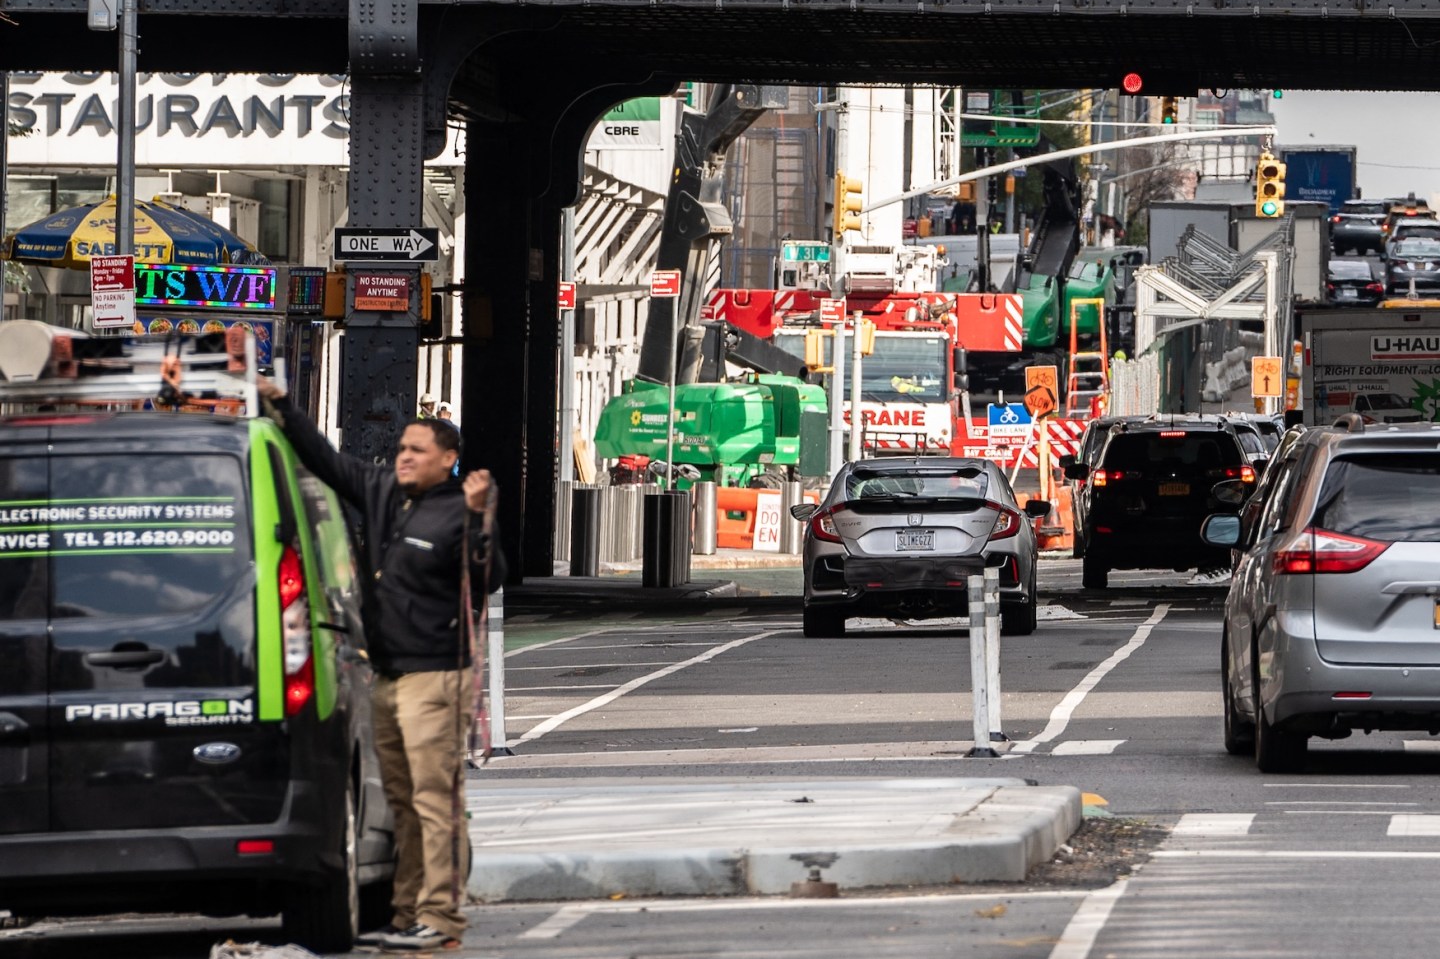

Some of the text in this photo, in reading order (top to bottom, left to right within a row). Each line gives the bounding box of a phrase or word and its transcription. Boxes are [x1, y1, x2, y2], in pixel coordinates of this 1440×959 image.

[604, 126, 640, 136] CBRE
[76, 241, 167, 258] SABETT
[349, 237, 423, 251] ONE WAY
[804, 247, 815, 260] 31
[102, 259, 127, 267] STANDING
[196, 272, 270, 303] W/F
[360, 277, 406, 287] NO STANDING
[366, 288, 398, 297] ANYTIME
[96, 303, 116, 312] Anytime
[1325, 366, 1356, 376] RIGHT
[1358, 365, 1418, 376] EQUIPMENT
[1029, 394, 1050, 410] SLOW
[963, 449, 980, 457] BAY
[88, 505, 163, 520] SECURITY
[165, 504, 235, 520] SYSTEMS
[761, 511, 779, 526] DO
[64, 531, 99, 547] TEL
[103, 530, 235, 546] 212.620.9000
[65, 699, 253, 722] PARAGON
[165, 714, 253, 726] SECURITY
